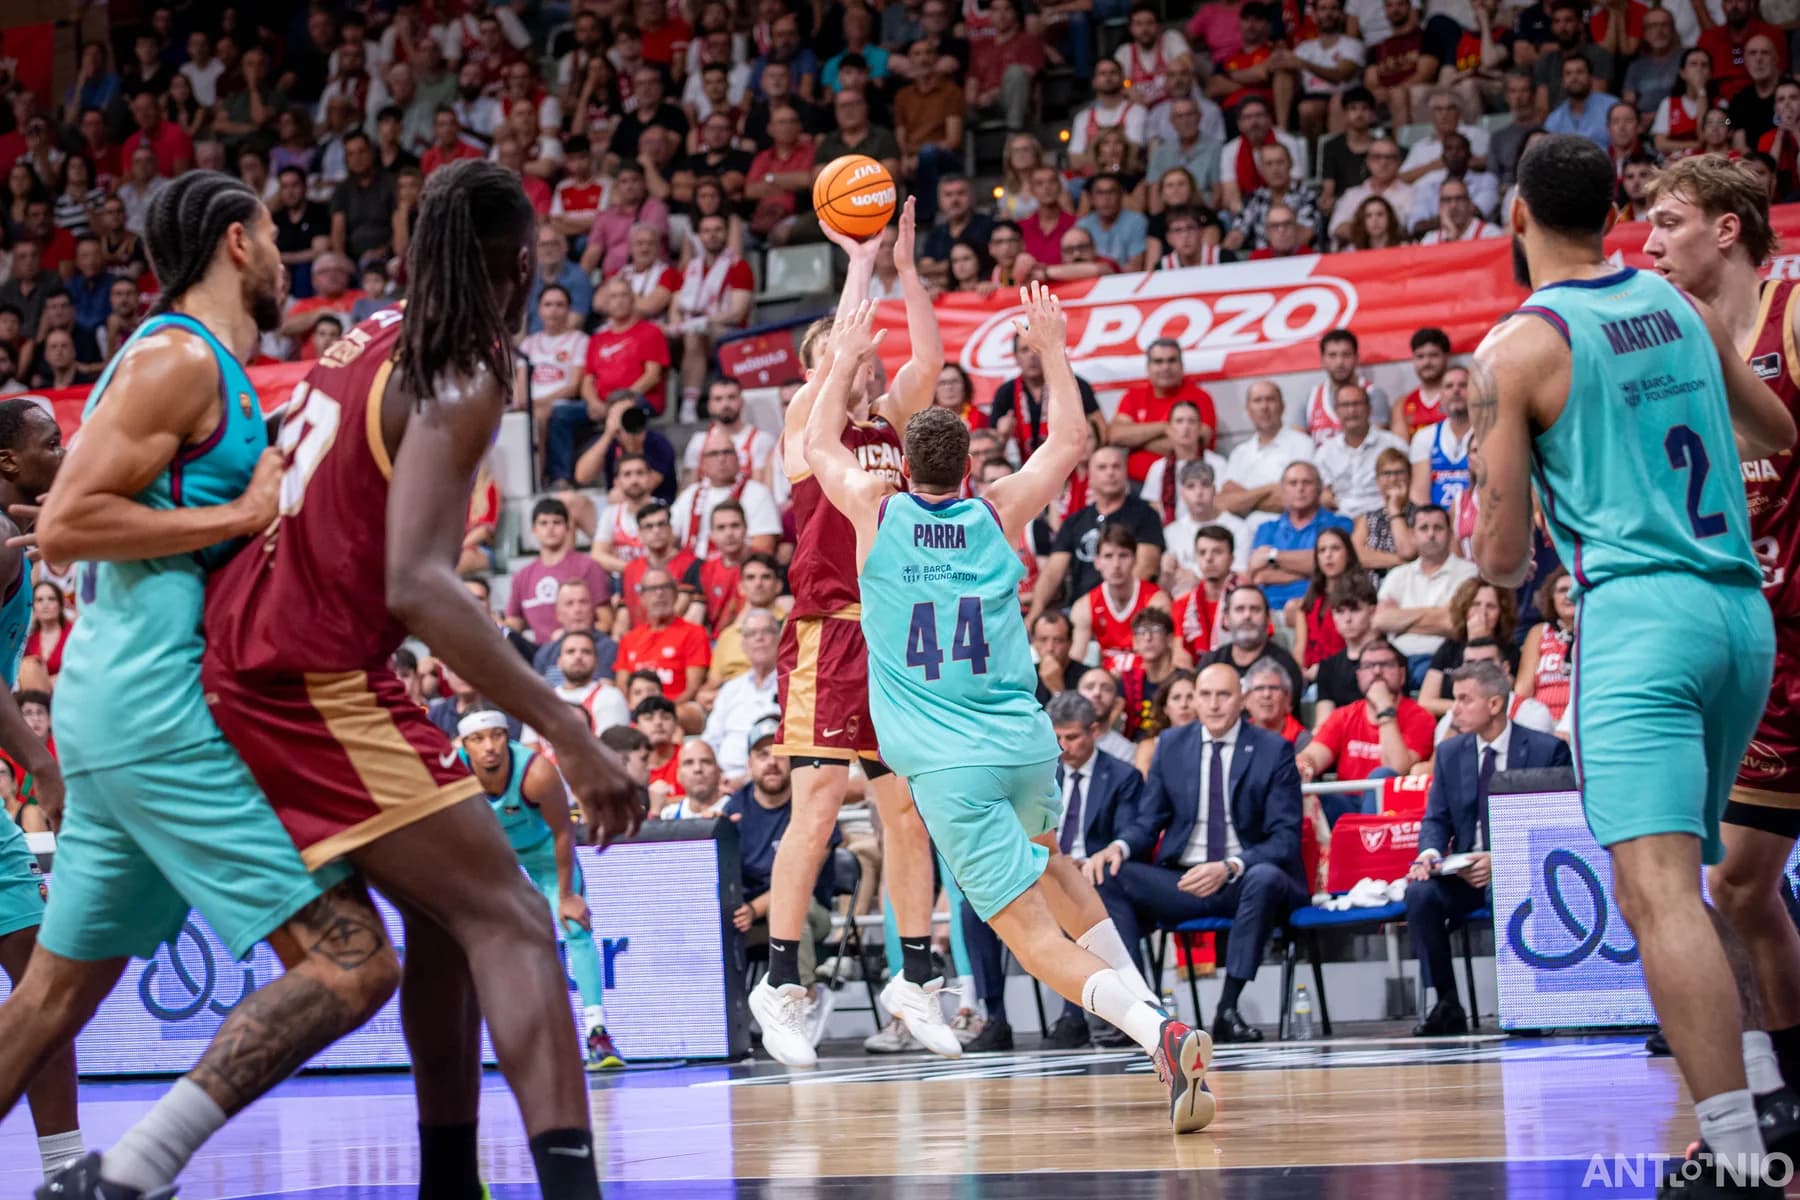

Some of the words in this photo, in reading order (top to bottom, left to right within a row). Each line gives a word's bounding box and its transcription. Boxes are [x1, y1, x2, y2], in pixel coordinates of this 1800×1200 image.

[1601, 309, 1684, 356] MARTIN
[1644, 379, 1706, 401] FOUNDATION
[1664, 424, 1728, 539] 2
[914, 524, 966, 548] PARRA
[924, 571, 978, 582] FOUNDATION
[906, 596, 990, 682] 44
